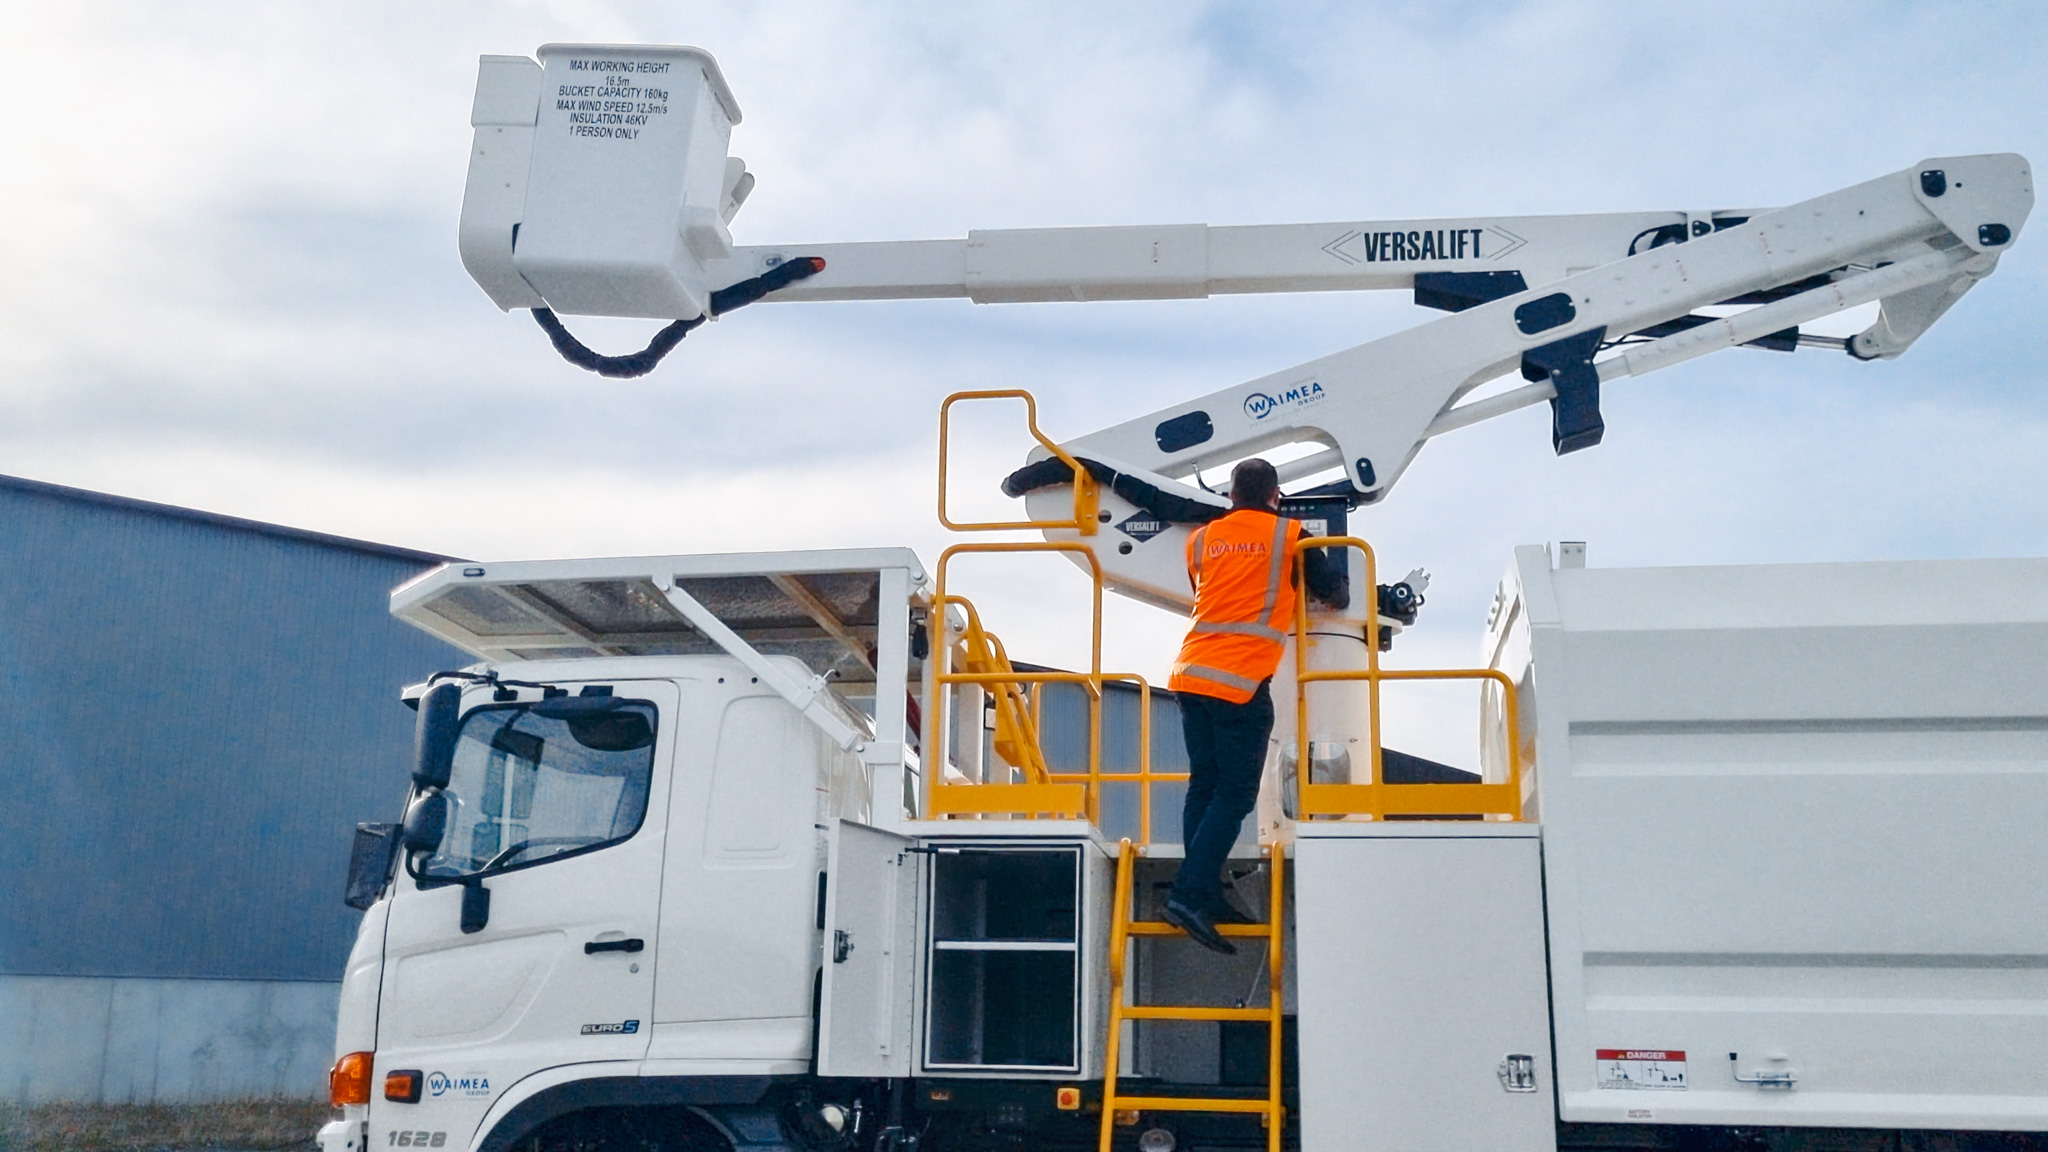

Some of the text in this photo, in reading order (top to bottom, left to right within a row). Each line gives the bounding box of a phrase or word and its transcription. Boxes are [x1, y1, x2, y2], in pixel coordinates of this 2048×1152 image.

[570, 60, 670, 74] MAX WORKING HEIGHT
[605, 76, 630, 86] 16.5m
[559, 86, 669, 102] BUCKET CAPACITY 160kg
[556, 100, 668, 114] MAX WIND SPEED 12.5m/s
[570, 112, 648, 125] INSULATION 46KV
[569, 126, 639, 139] 1 PERSON ONLY
[1364, 229, 1483, 262] VERSALIFT
[1248, 382, 1323, 413] WAIMEA
[1298, 393, 1326, 406] GROUP
[1211, 542, 1266, 555] WAIMEA
[1626, 1051, 1666, 1060] DANGER
[388, 1130, 447, 1148] 1628
